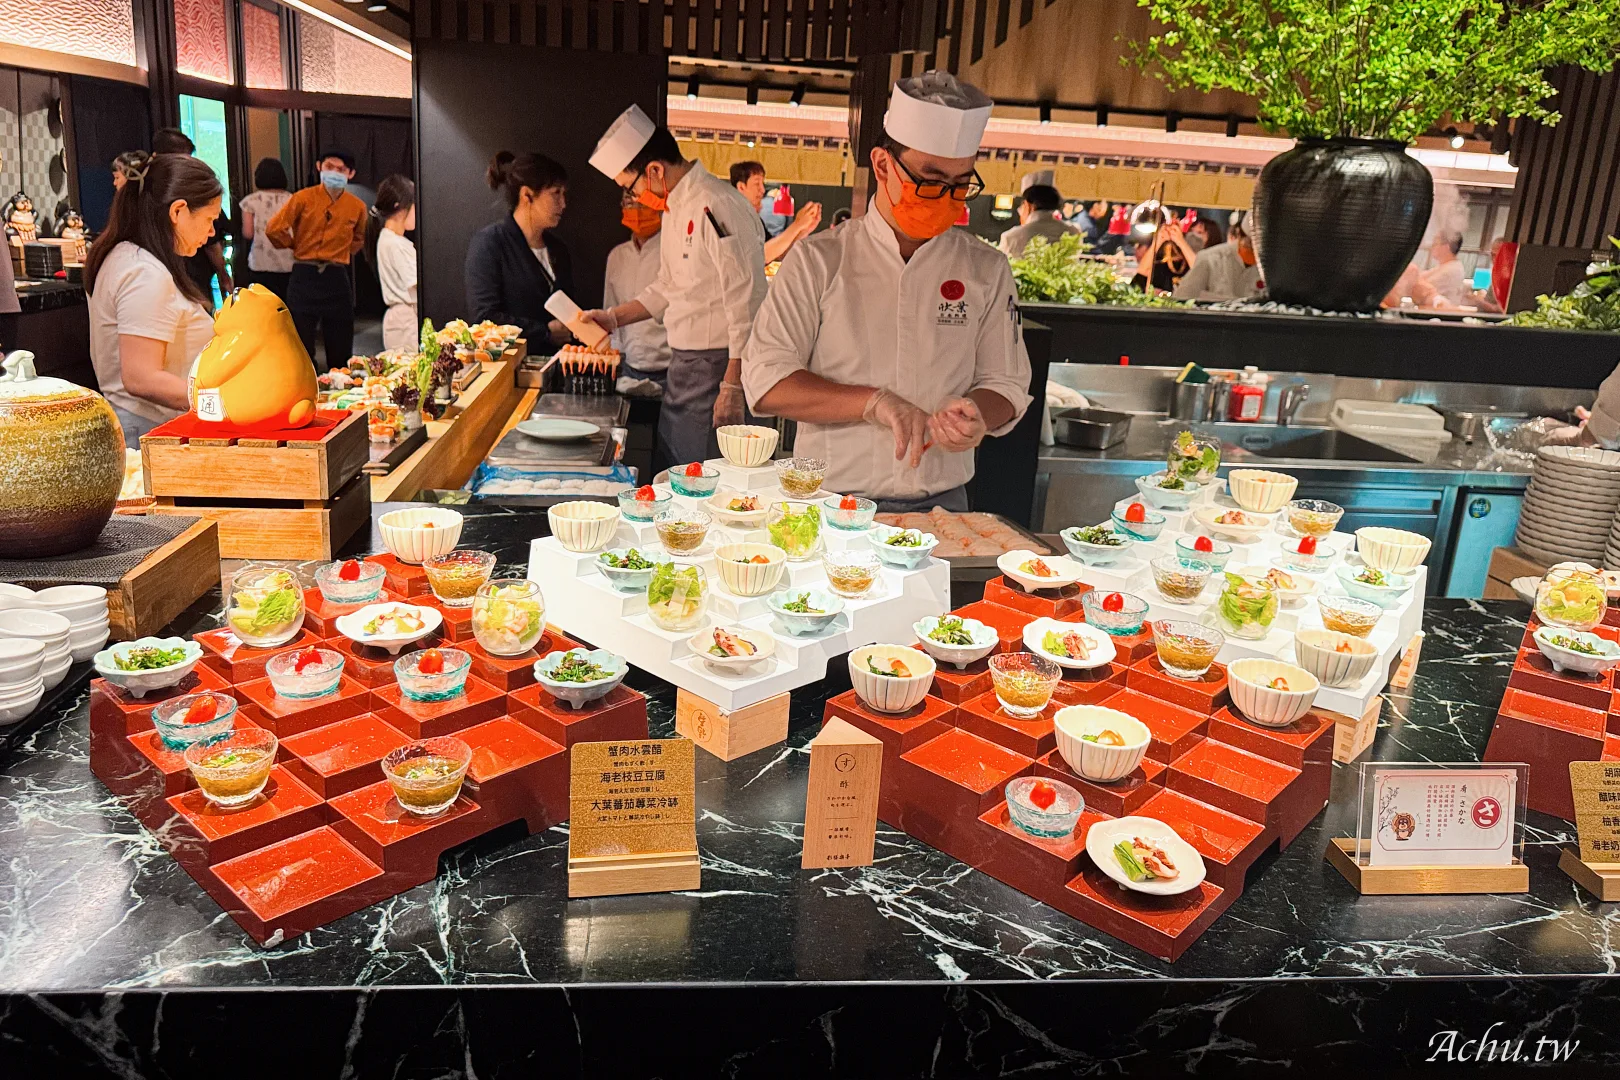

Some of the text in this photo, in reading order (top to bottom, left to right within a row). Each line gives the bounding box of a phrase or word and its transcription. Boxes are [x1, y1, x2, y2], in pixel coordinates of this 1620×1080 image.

[600, 770, 665, 783] 海老枝豆豆腐
[1598, 792, 1620, 802] 醋味
[1477, 800, 1495, 824] さ
